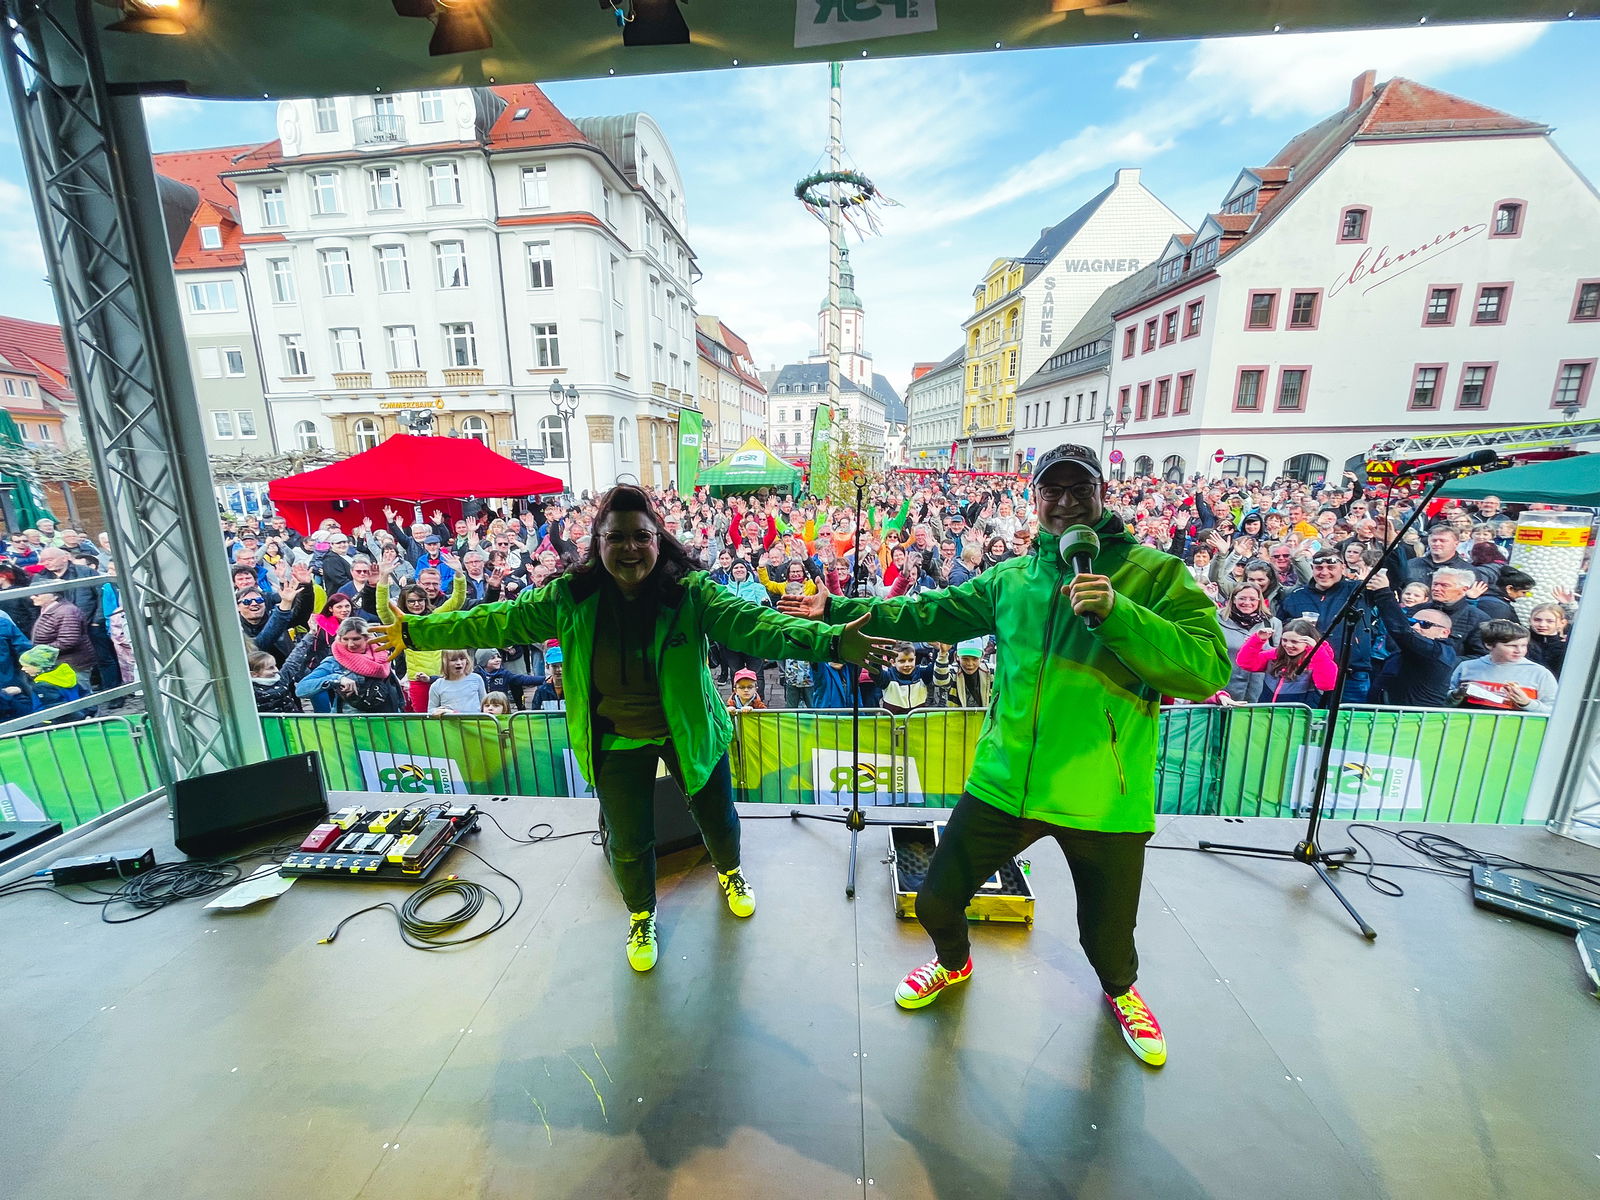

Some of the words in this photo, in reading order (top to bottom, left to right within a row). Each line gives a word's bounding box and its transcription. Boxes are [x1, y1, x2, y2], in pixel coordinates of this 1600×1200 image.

[1065, 258, 1140, 273] WAGNER
[1040, 276, 1056, 347] SAMEN
[380, 401, 434, 409] COMMERZBANK
